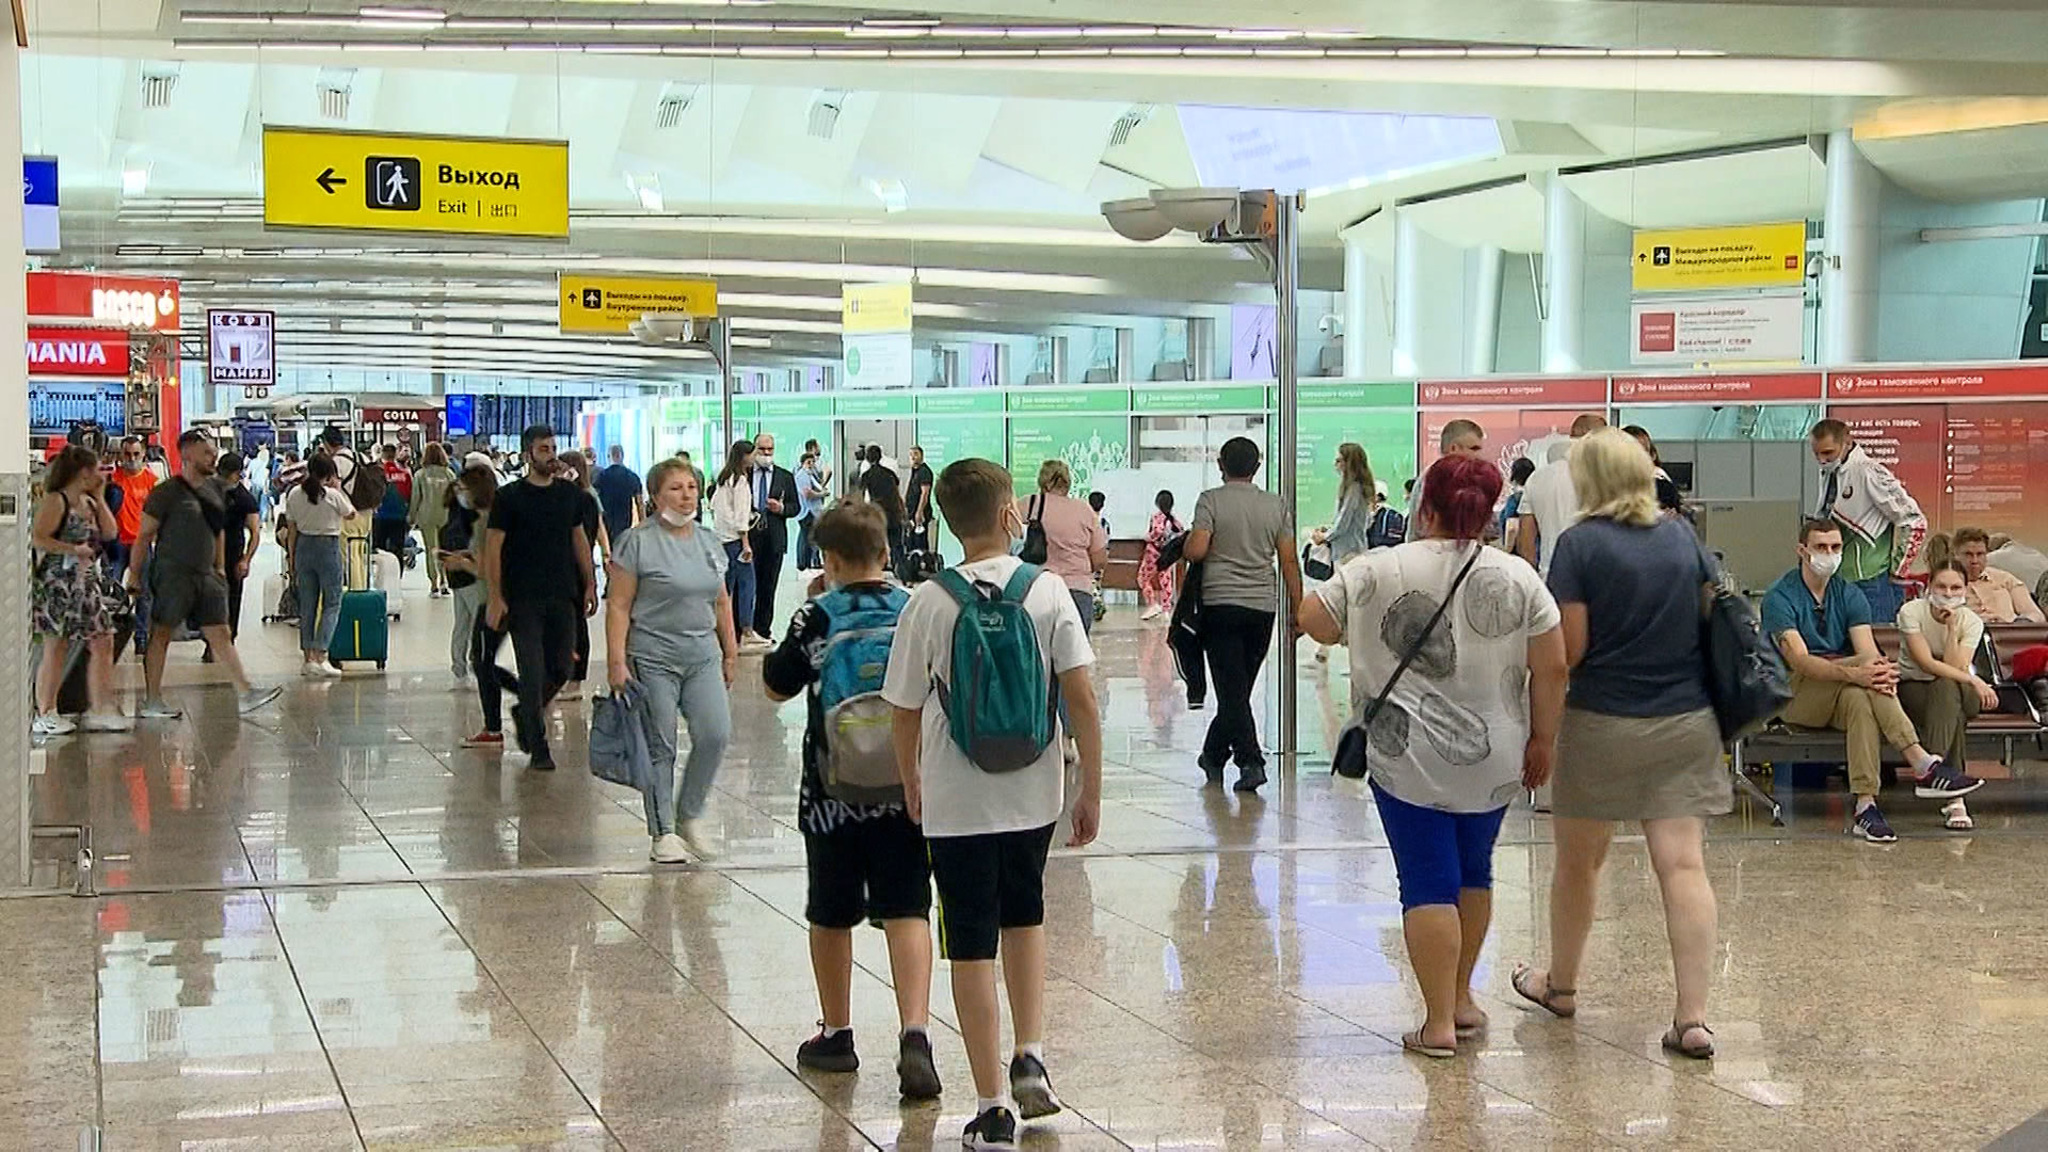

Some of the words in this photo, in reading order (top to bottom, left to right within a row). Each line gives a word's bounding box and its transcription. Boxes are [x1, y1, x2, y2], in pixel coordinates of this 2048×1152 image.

[438, 164, 520, 189] Выход
[438, 200, 467, 214] Exit
[1856, 377, 1878, 387] Зона
[1941, 376, 1984, 388] контроля
[383, 410, 419, 421] COSTA
